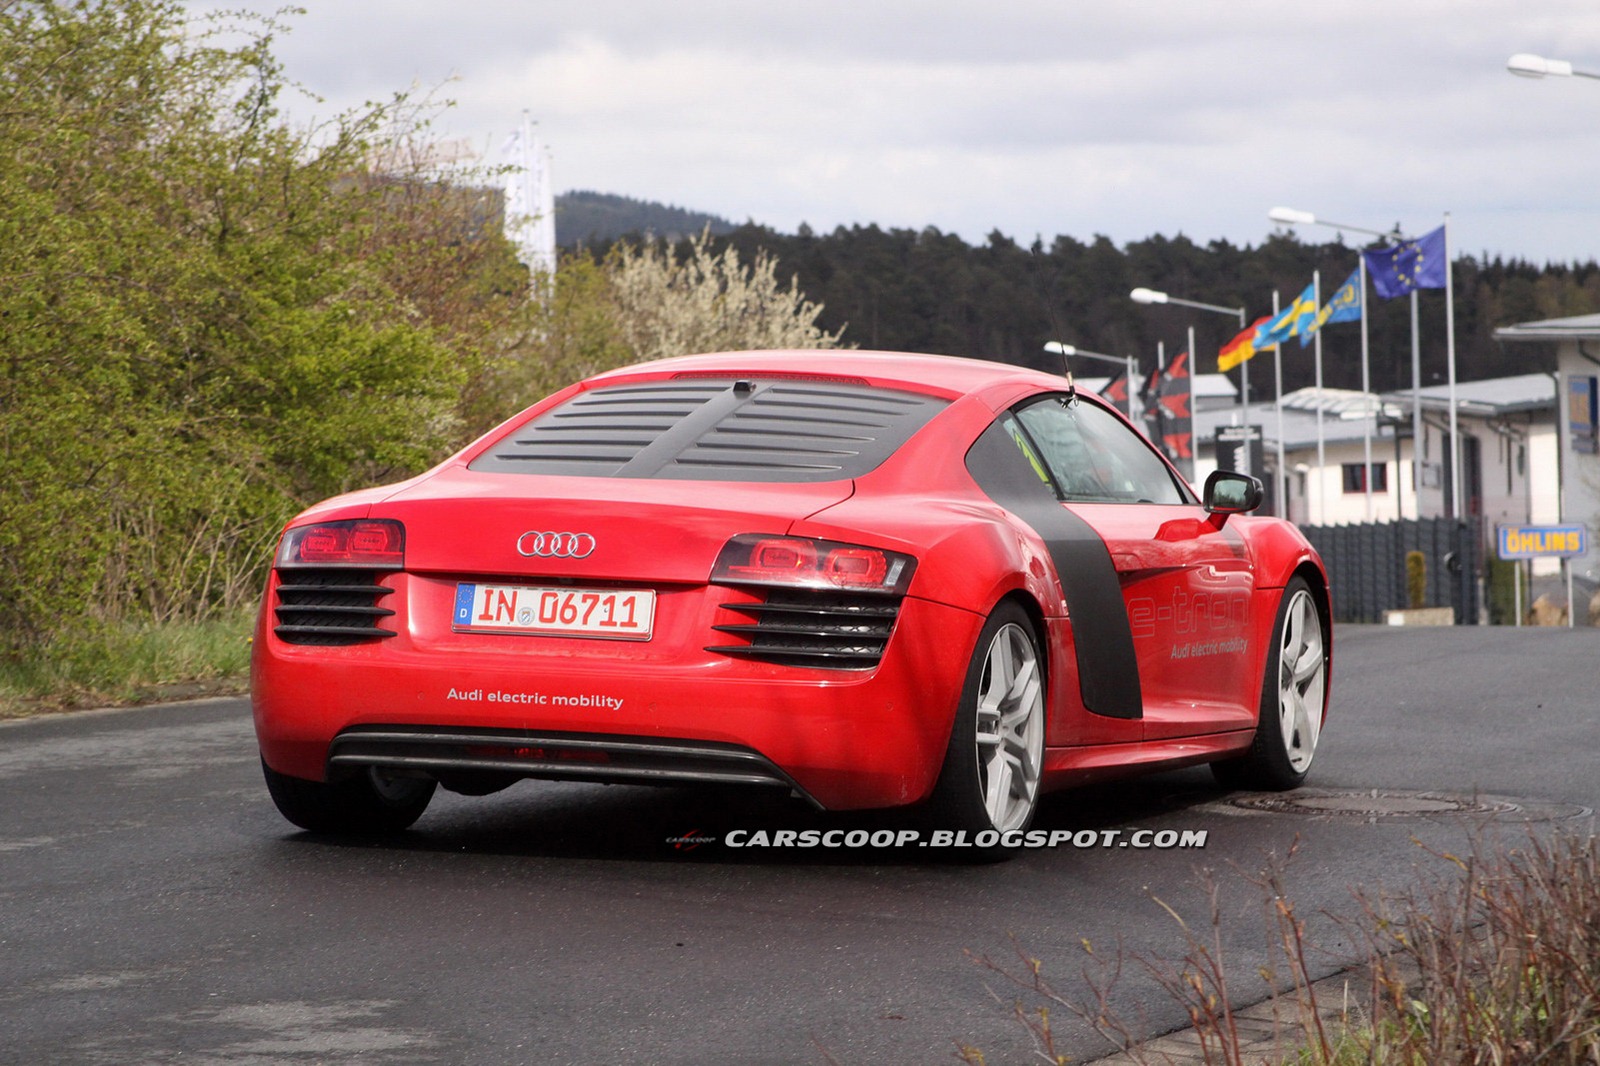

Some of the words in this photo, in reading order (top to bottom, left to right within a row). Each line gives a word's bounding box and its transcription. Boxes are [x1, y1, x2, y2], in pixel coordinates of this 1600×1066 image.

[1506, 527, 1580, 553] ÖHLINS
[459, 608, 468, 618] D
[478, 589, 518, 622] IN
[538, 592, 638, 628] 06711
[1127, 586, 1249, 639] e-tron
[1170, 642, 1190, 660] Audi
[1191, 639, 1218, 657] electric
[1219, 636, 1249, 655] mobility
[446, 687, 483, 702] Audi
[487, 690, 548, 705] electric
[551, 693, 624, 711] mobility
